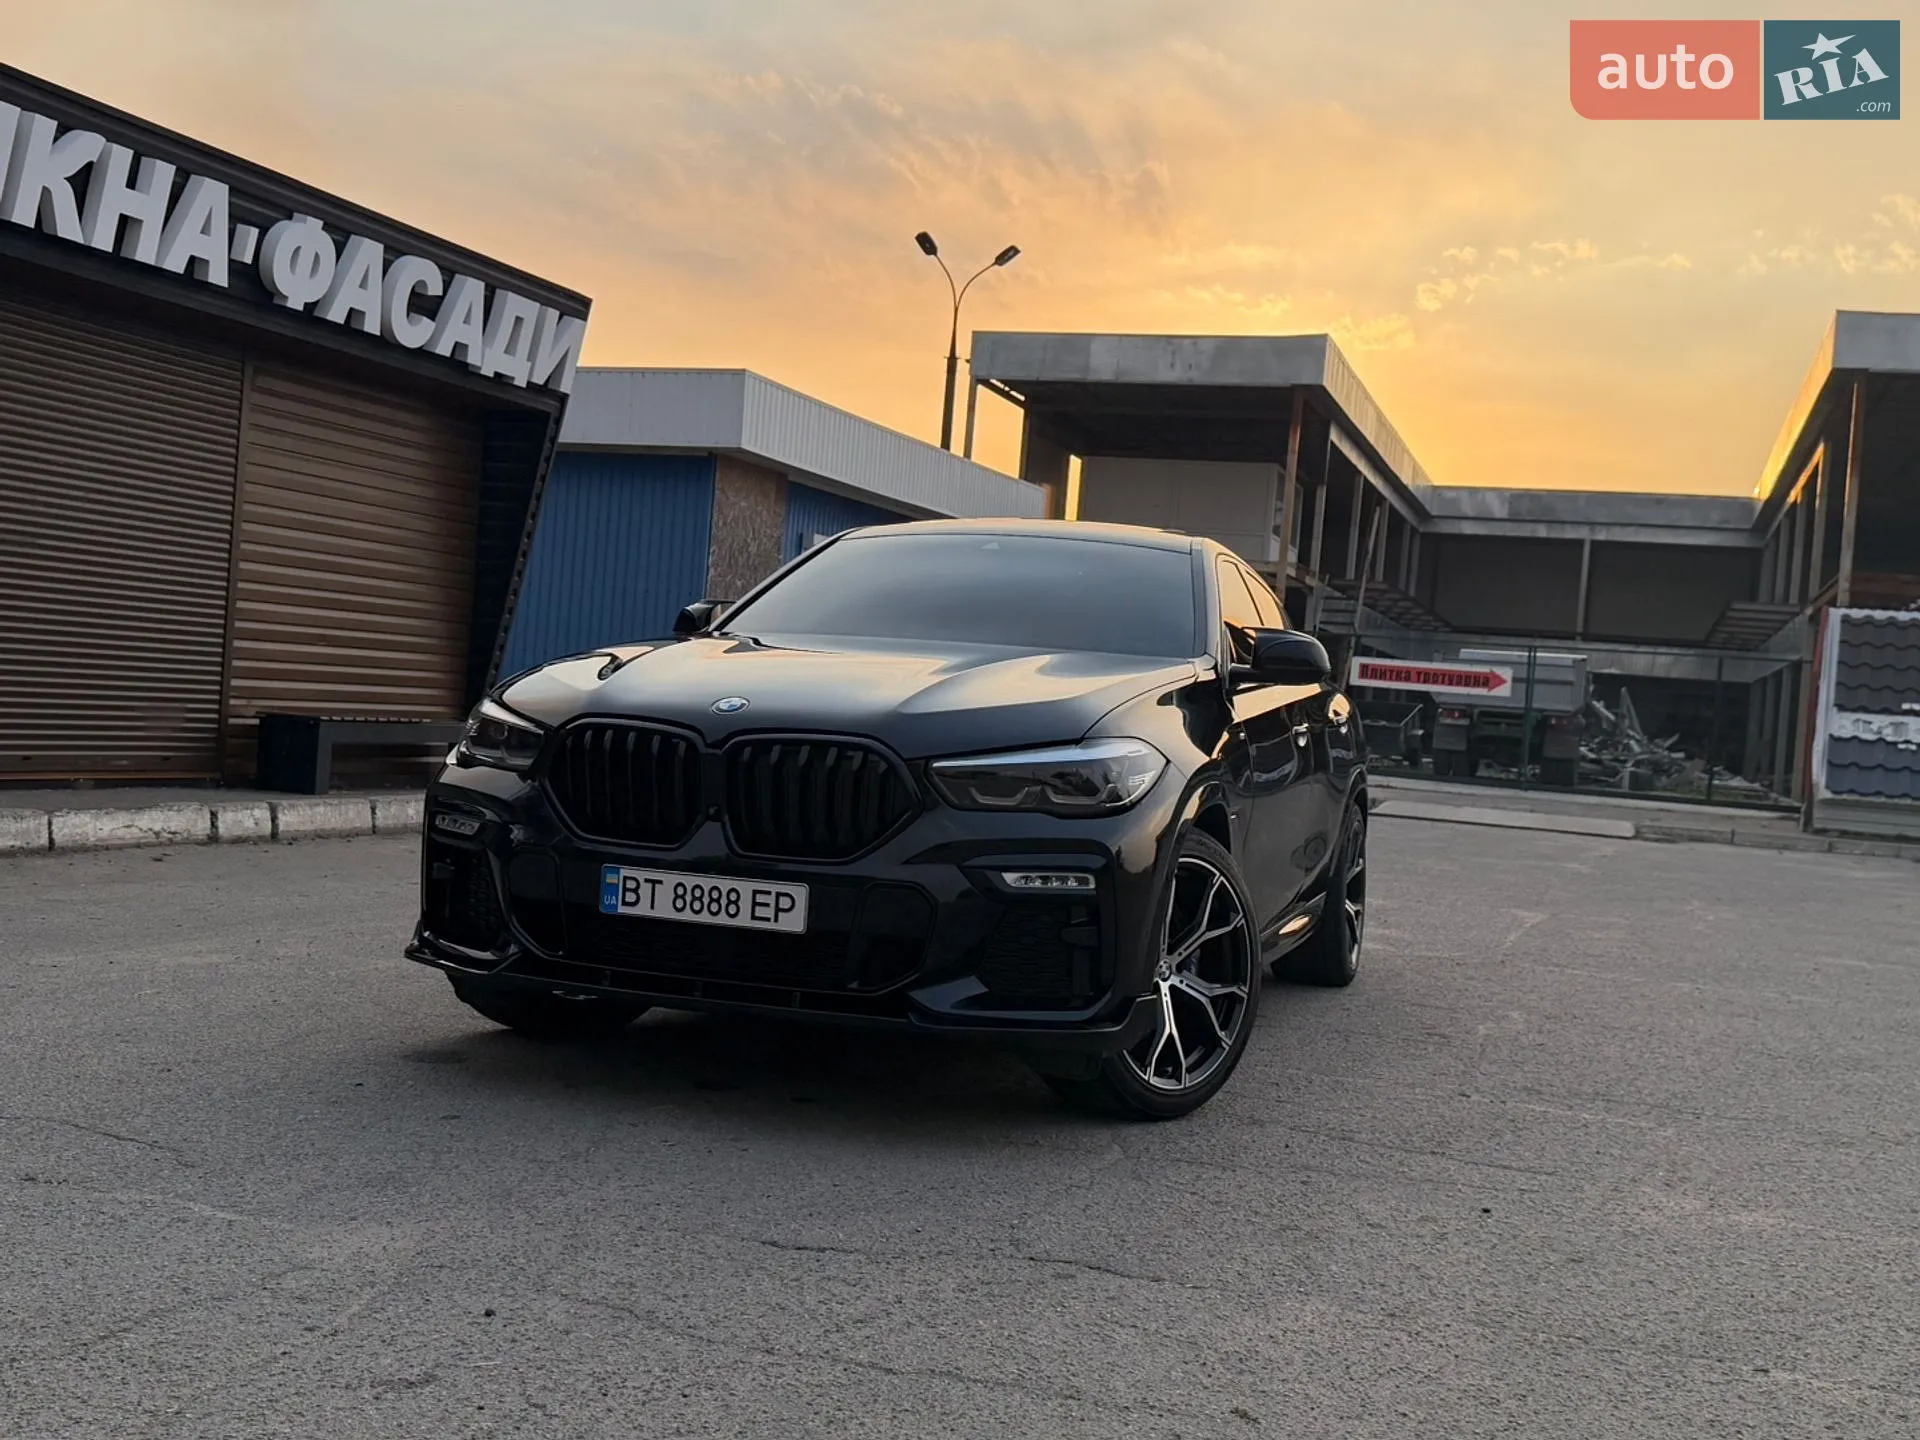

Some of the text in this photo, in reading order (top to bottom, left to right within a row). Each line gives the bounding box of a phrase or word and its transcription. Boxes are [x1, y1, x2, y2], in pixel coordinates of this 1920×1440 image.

[621, 875, 796, 923] BT 8888 EP
